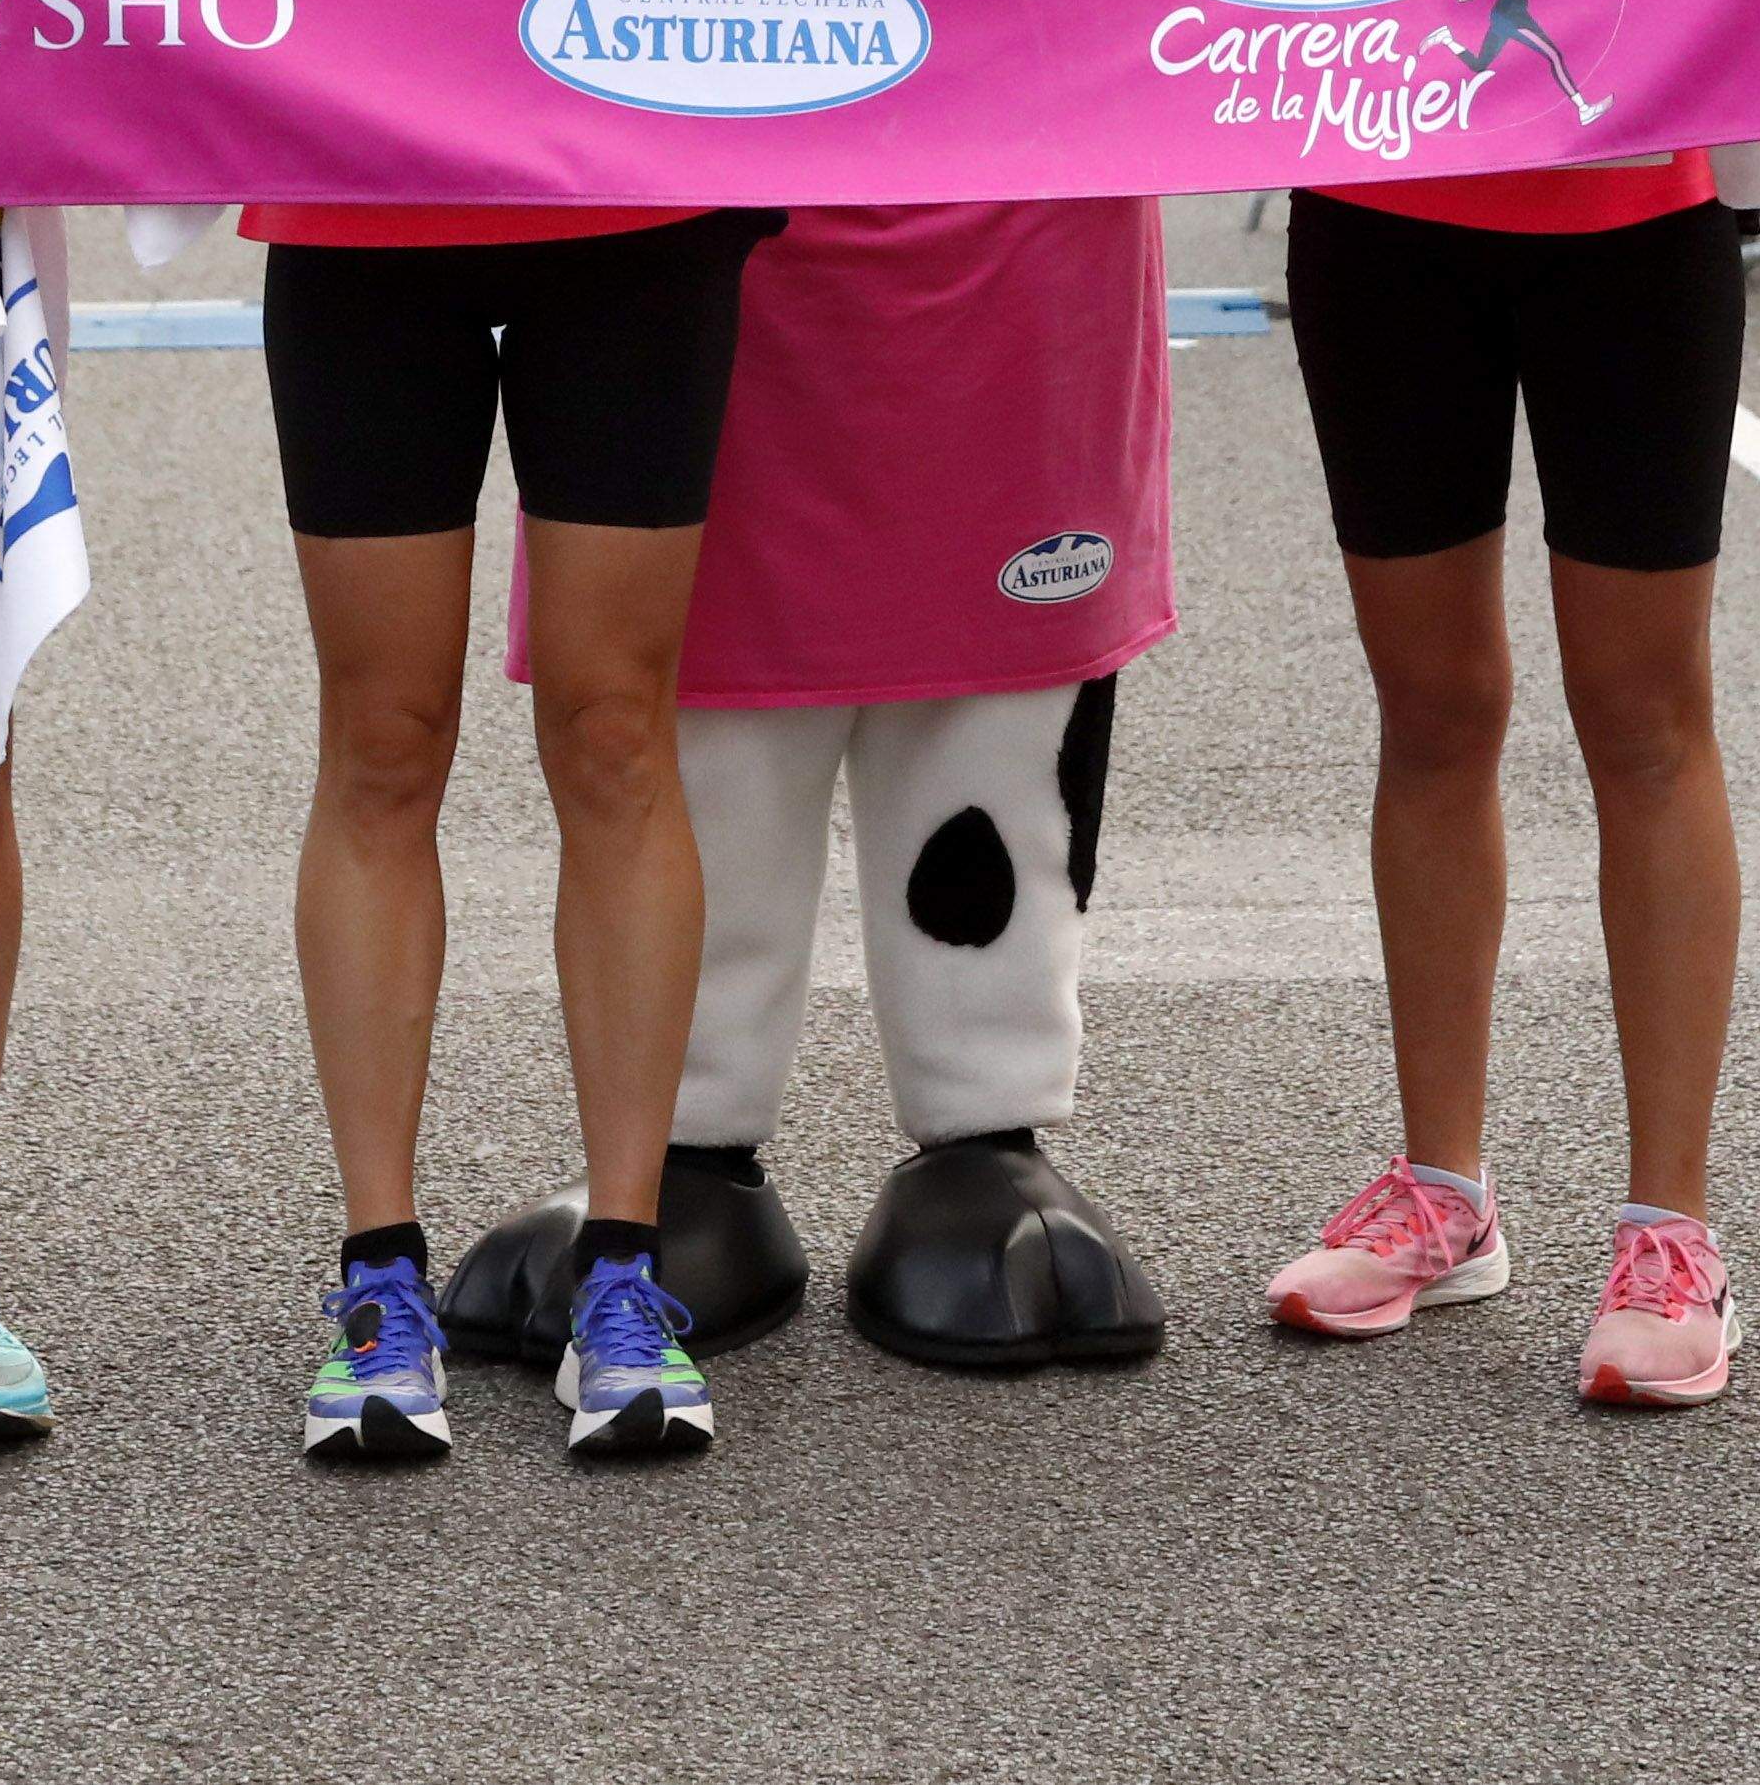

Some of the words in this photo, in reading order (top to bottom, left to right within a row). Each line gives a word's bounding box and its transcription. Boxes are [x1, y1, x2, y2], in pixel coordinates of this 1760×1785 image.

[1149, 6, 1401, 75] Carrera
[1214, 77, 1261, 124] de
[1271, 76, 1305, 122] la
[1299, 53, 1497, 160] Mujer
[1012, 555, 1106, 590] ASTURIANA
